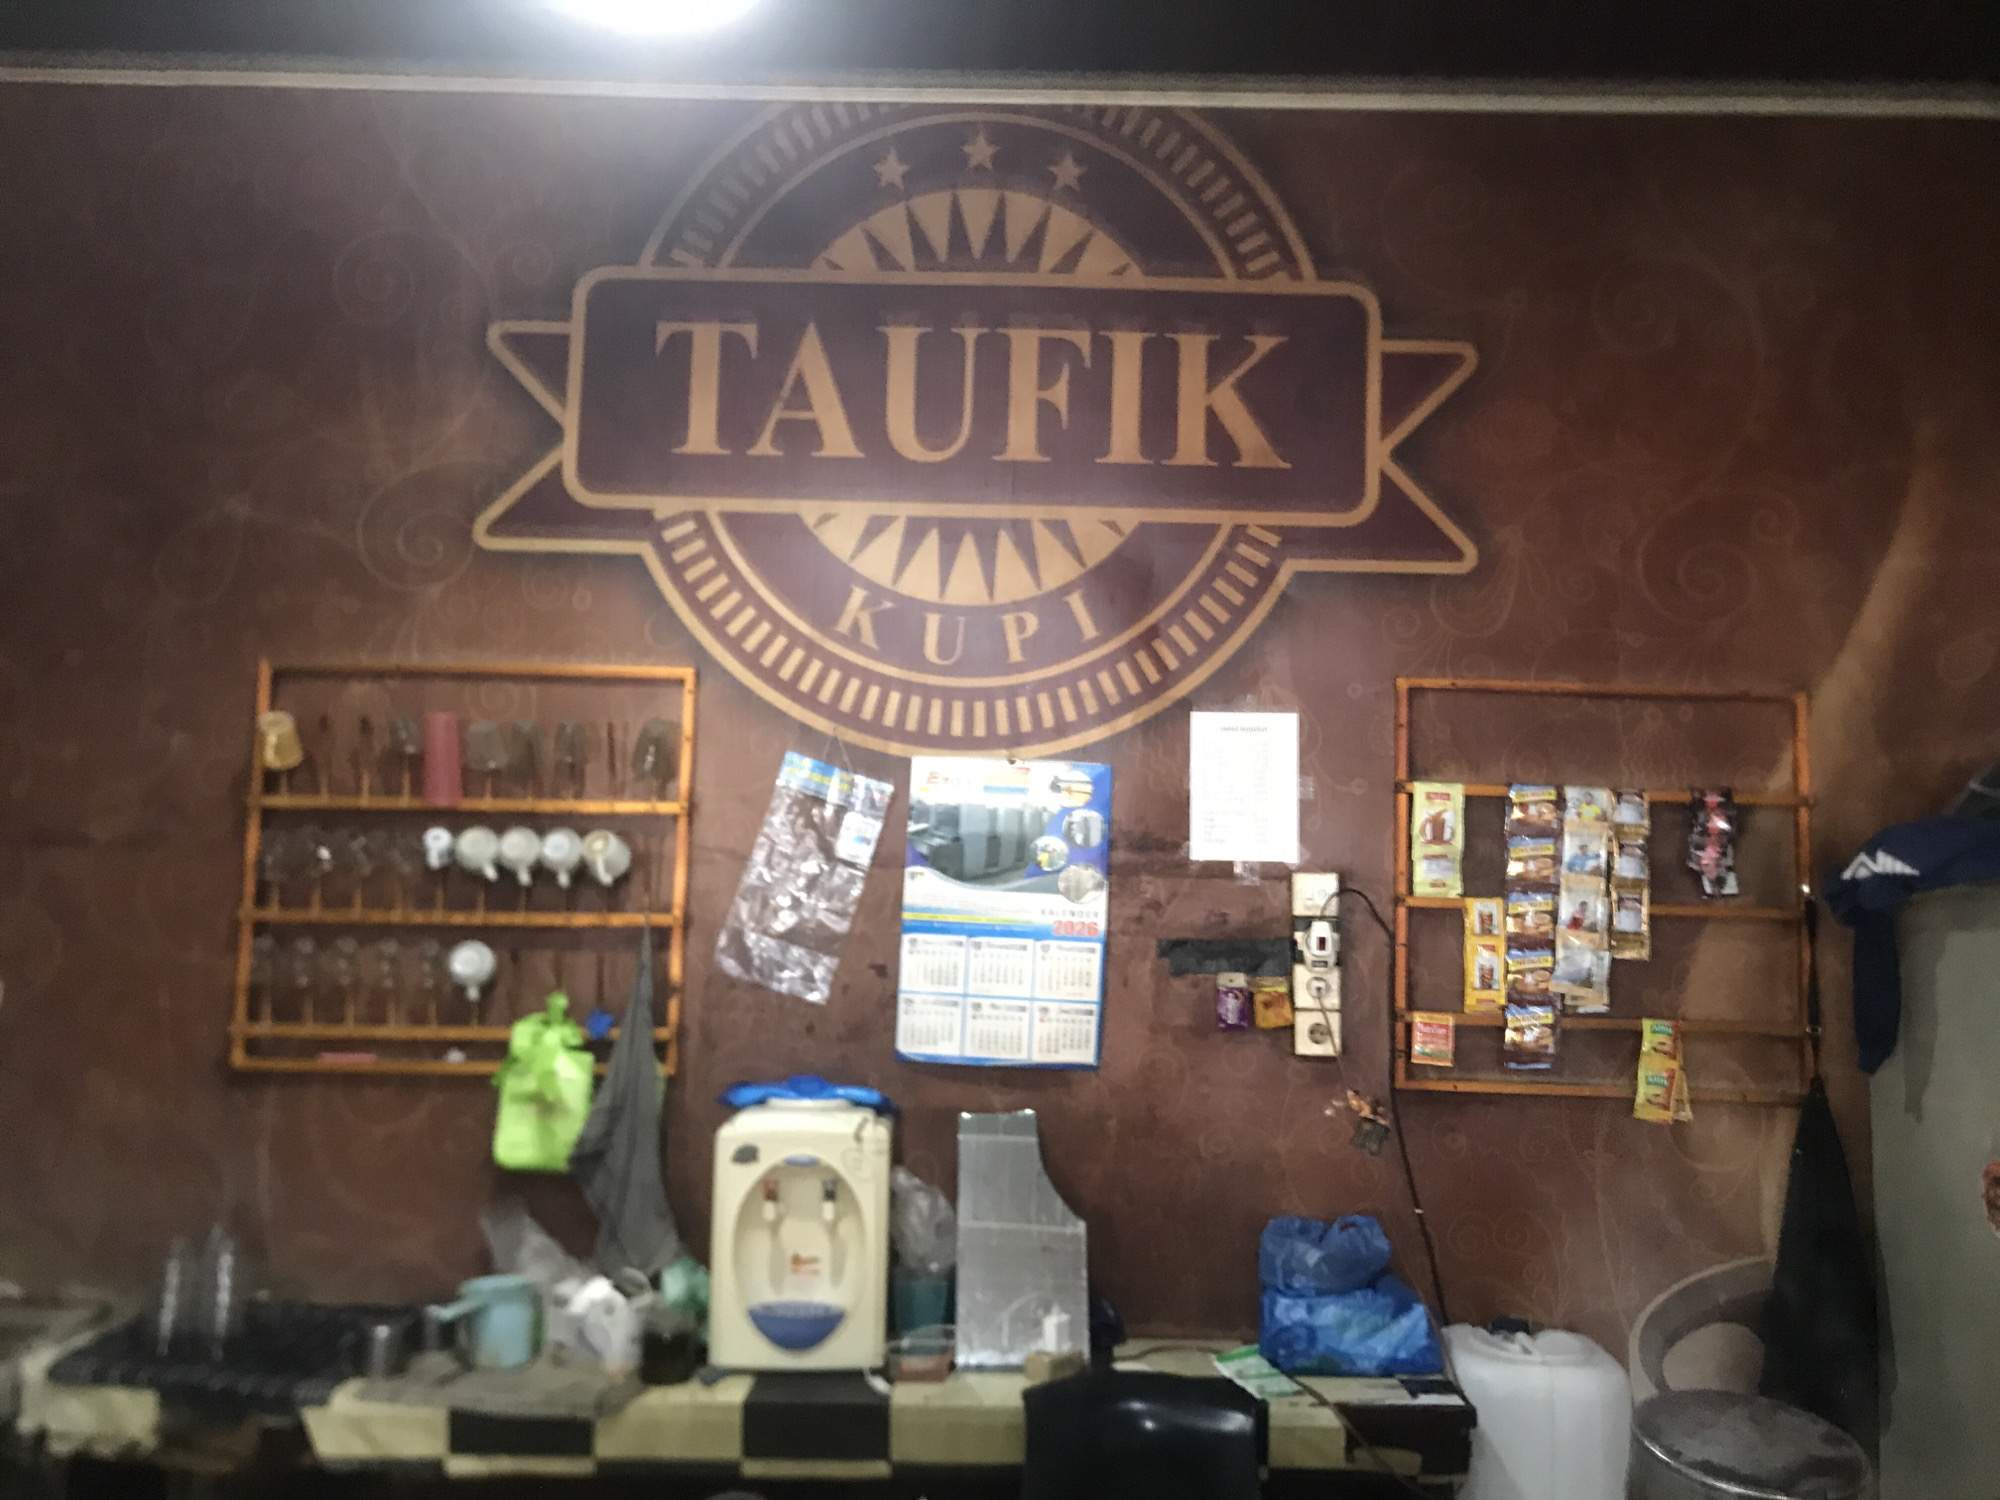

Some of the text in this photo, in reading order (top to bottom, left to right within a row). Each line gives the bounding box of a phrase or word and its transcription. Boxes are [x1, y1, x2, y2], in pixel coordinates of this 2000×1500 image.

[655, 320, 1293, 470] TAUFIK
[836, 584, 1100, 666] KUPI
[1052, 920, 1099, 938] 2026
